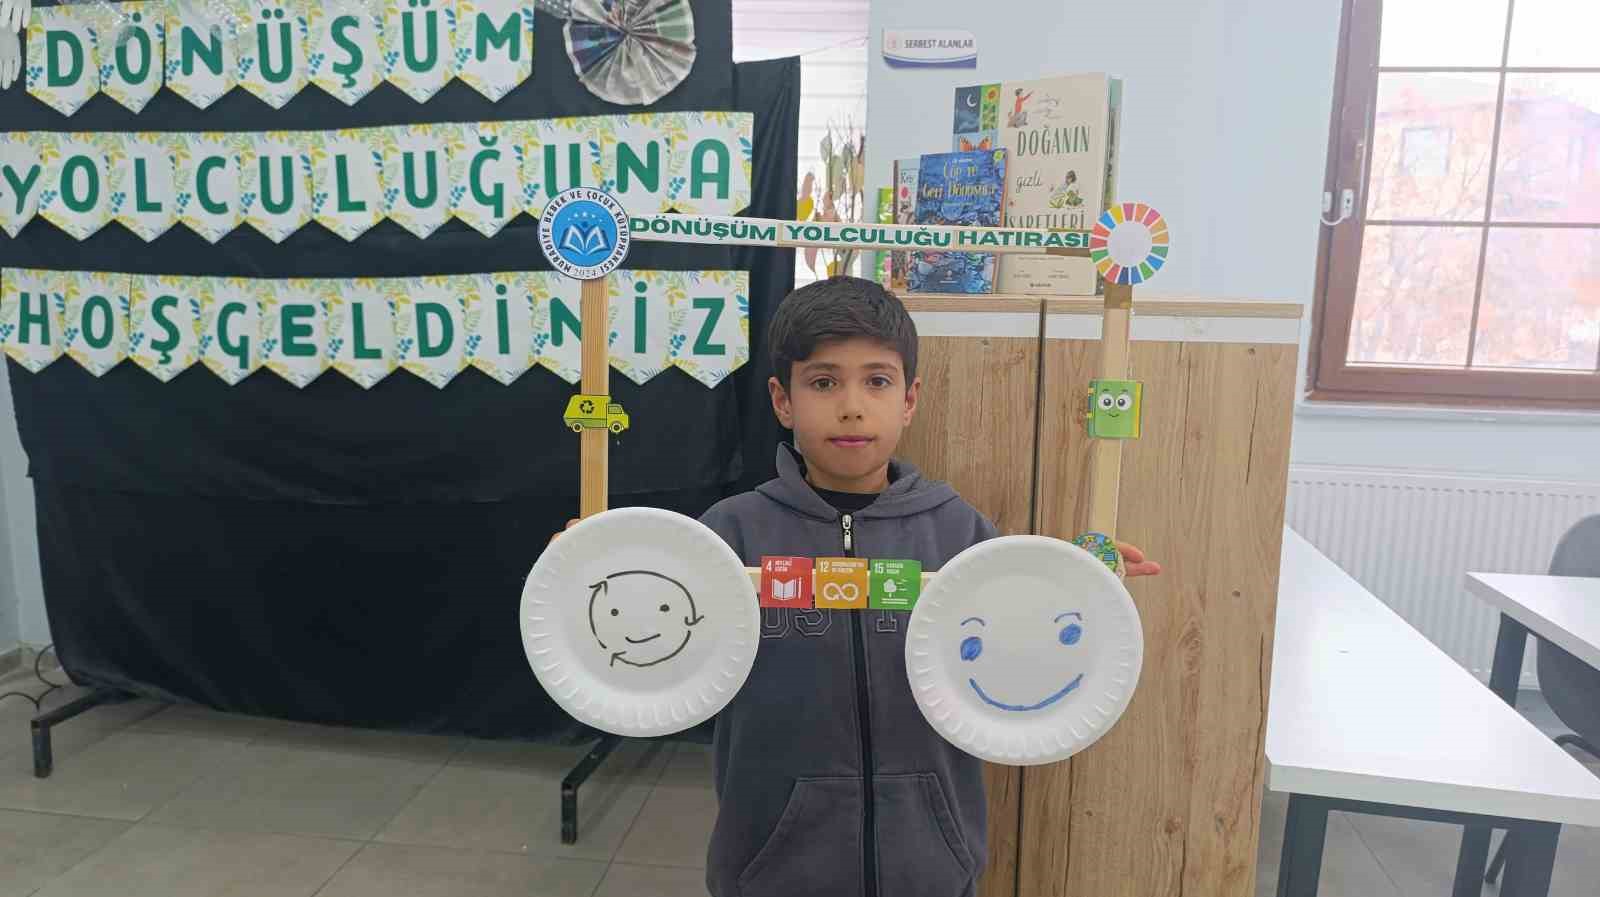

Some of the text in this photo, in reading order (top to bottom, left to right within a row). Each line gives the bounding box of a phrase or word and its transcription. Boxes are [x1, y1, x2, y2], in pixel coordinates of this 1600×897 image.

[46, 0, 521, 89] DÖNÜŞÜM
[904, 39, 973, 49] SERBEST ALANLAR
[1016, 122, 1090, 157] DOĞANIN
[2, 136, 731, 218] YOLCULUĞUNA
[544, 196, 567, 223] BEBEK
[569, 191, 582, 199] VE
[629, 216, 1089, 247] DÖNÜŞÜM YOLCULUĞU HATIRASI
[18, 281, 726, 370] HOŞGELDİNİZ
[766, 560, 772, 573] 4
[819, 560, 830, 574] 12
[874, 562, 885, 574] 15
